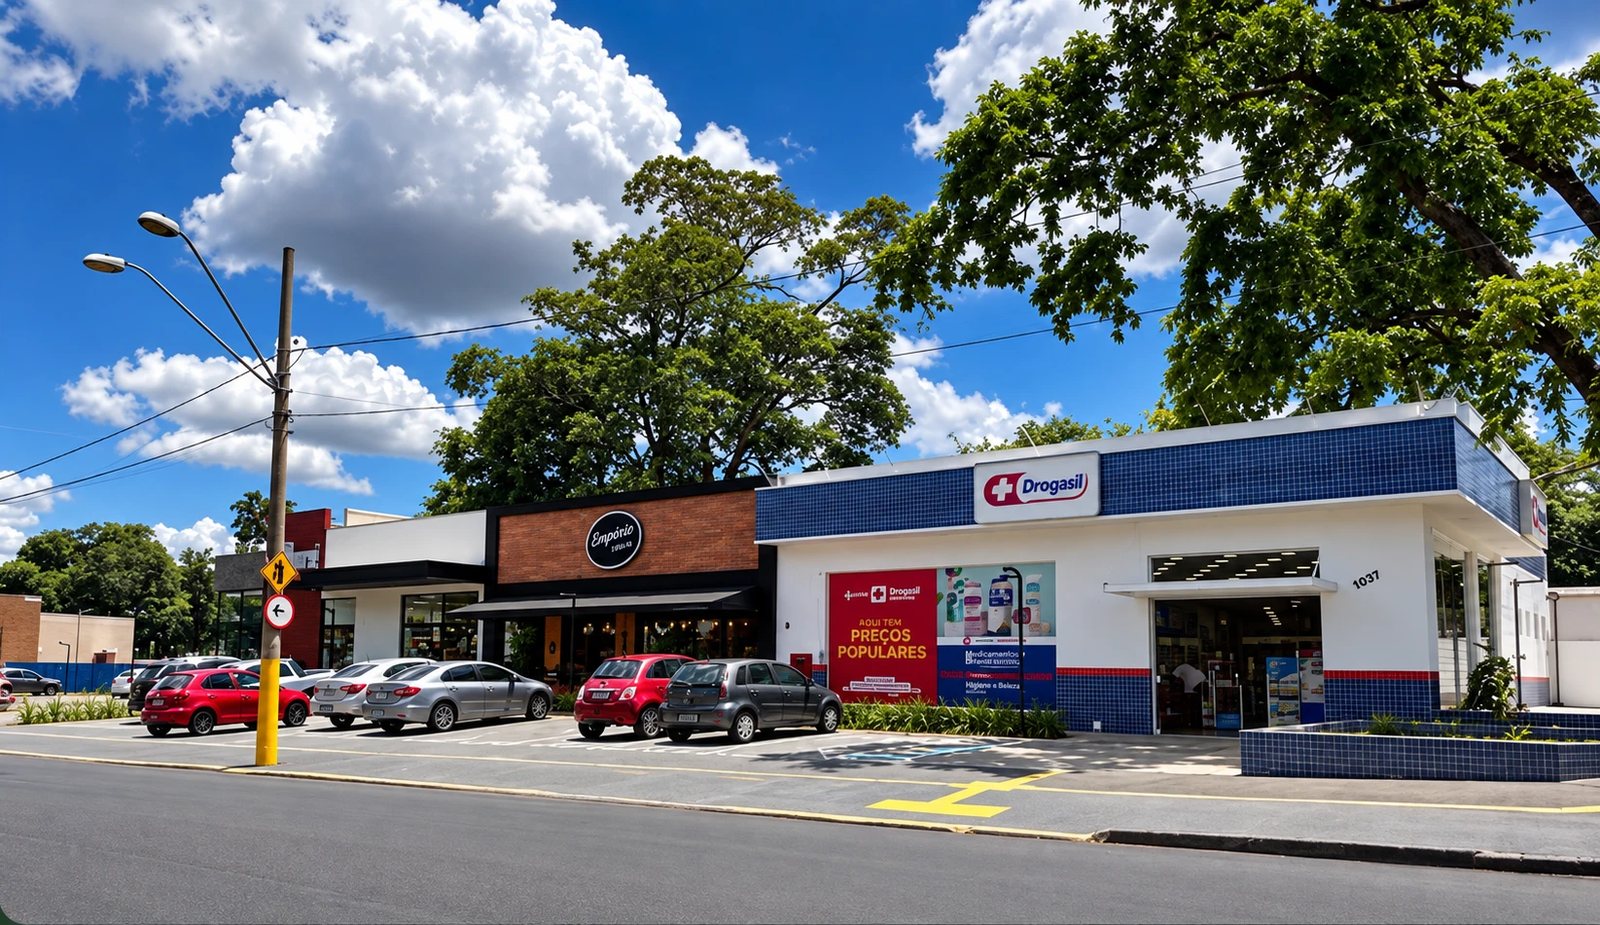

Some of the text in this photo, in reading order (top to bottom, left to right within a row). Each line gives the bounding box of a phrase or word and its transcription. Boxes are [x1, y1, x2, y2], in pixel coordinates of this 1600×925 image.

[1022, 473, 1083, 495] Drogasil
[591, 523, 634, 547] Empório
[1352, 569, 1379, 590] 1037
[889, 586, 921, 596] Drogasil
[859, 618, 902, 627] AQUI TEM
[851, 628, 911, 645] PREÇOS
[838, 645, 927, 659] POPULARES
